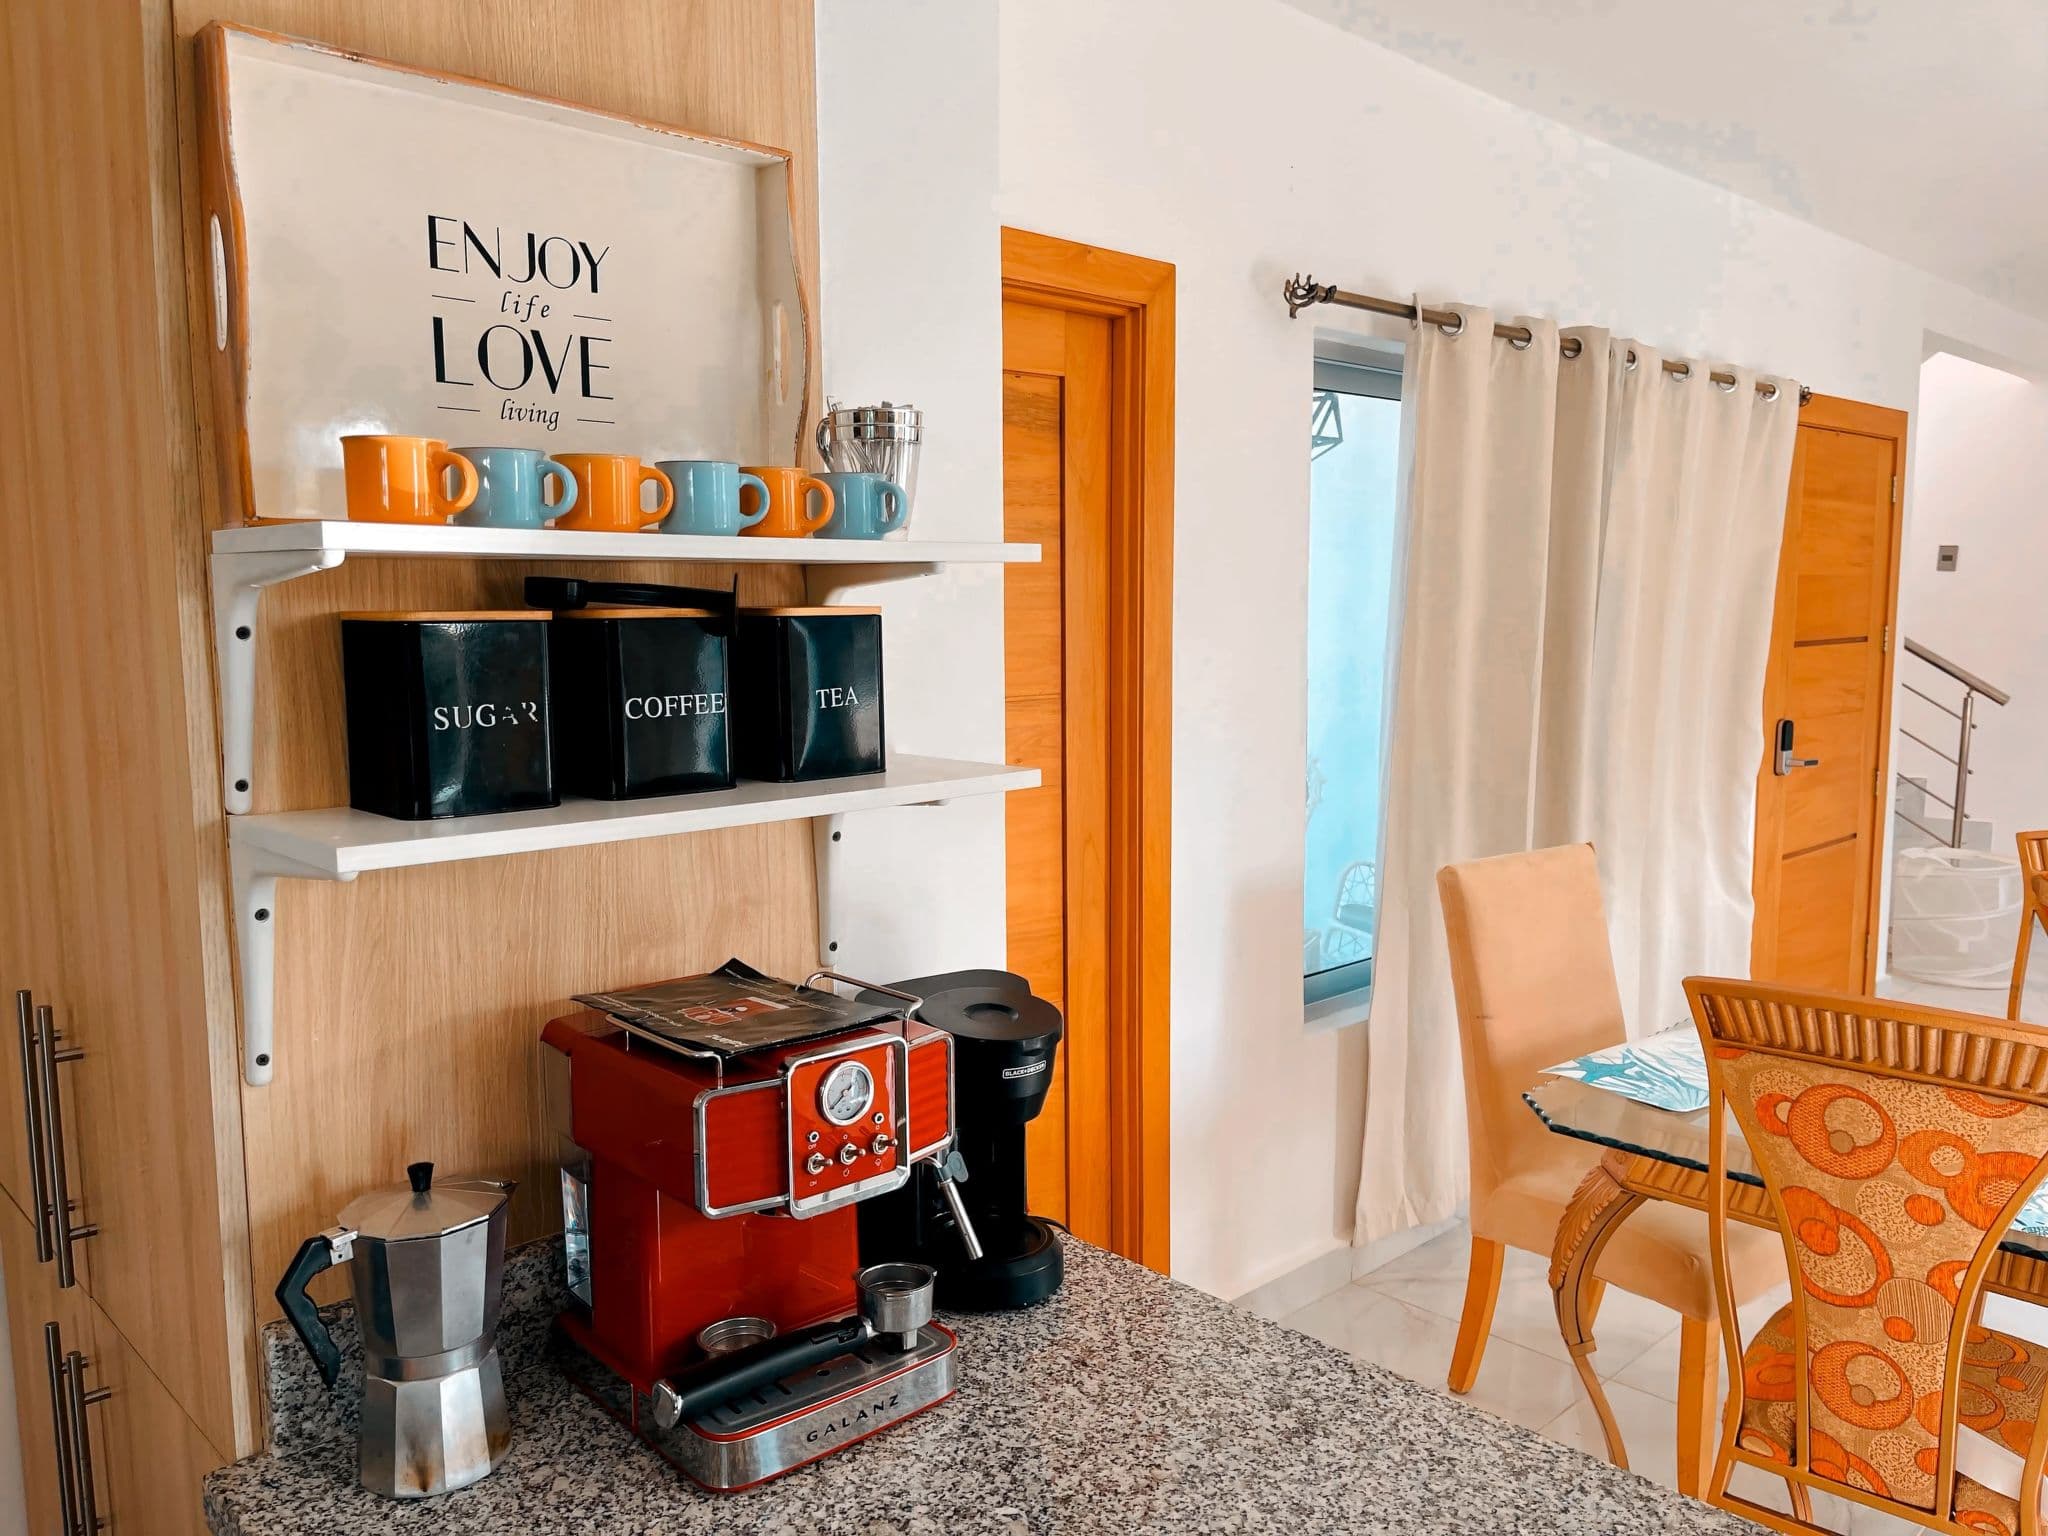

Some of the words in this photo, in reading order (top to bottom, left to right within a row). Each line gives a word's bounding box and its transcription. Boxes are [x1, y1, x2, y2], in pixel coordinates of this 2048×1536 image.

[428, 214, 610, 294] ENJOY
[501, 290, 551, 323] life
[433, 316, 614, 400] LOVE
[500, 398, 560, 432] living
[625, 692, 725, 719] COFFEE
[815, 685, 860, 709] TEA
[806, 1393, 899, 1443] GALANZ
